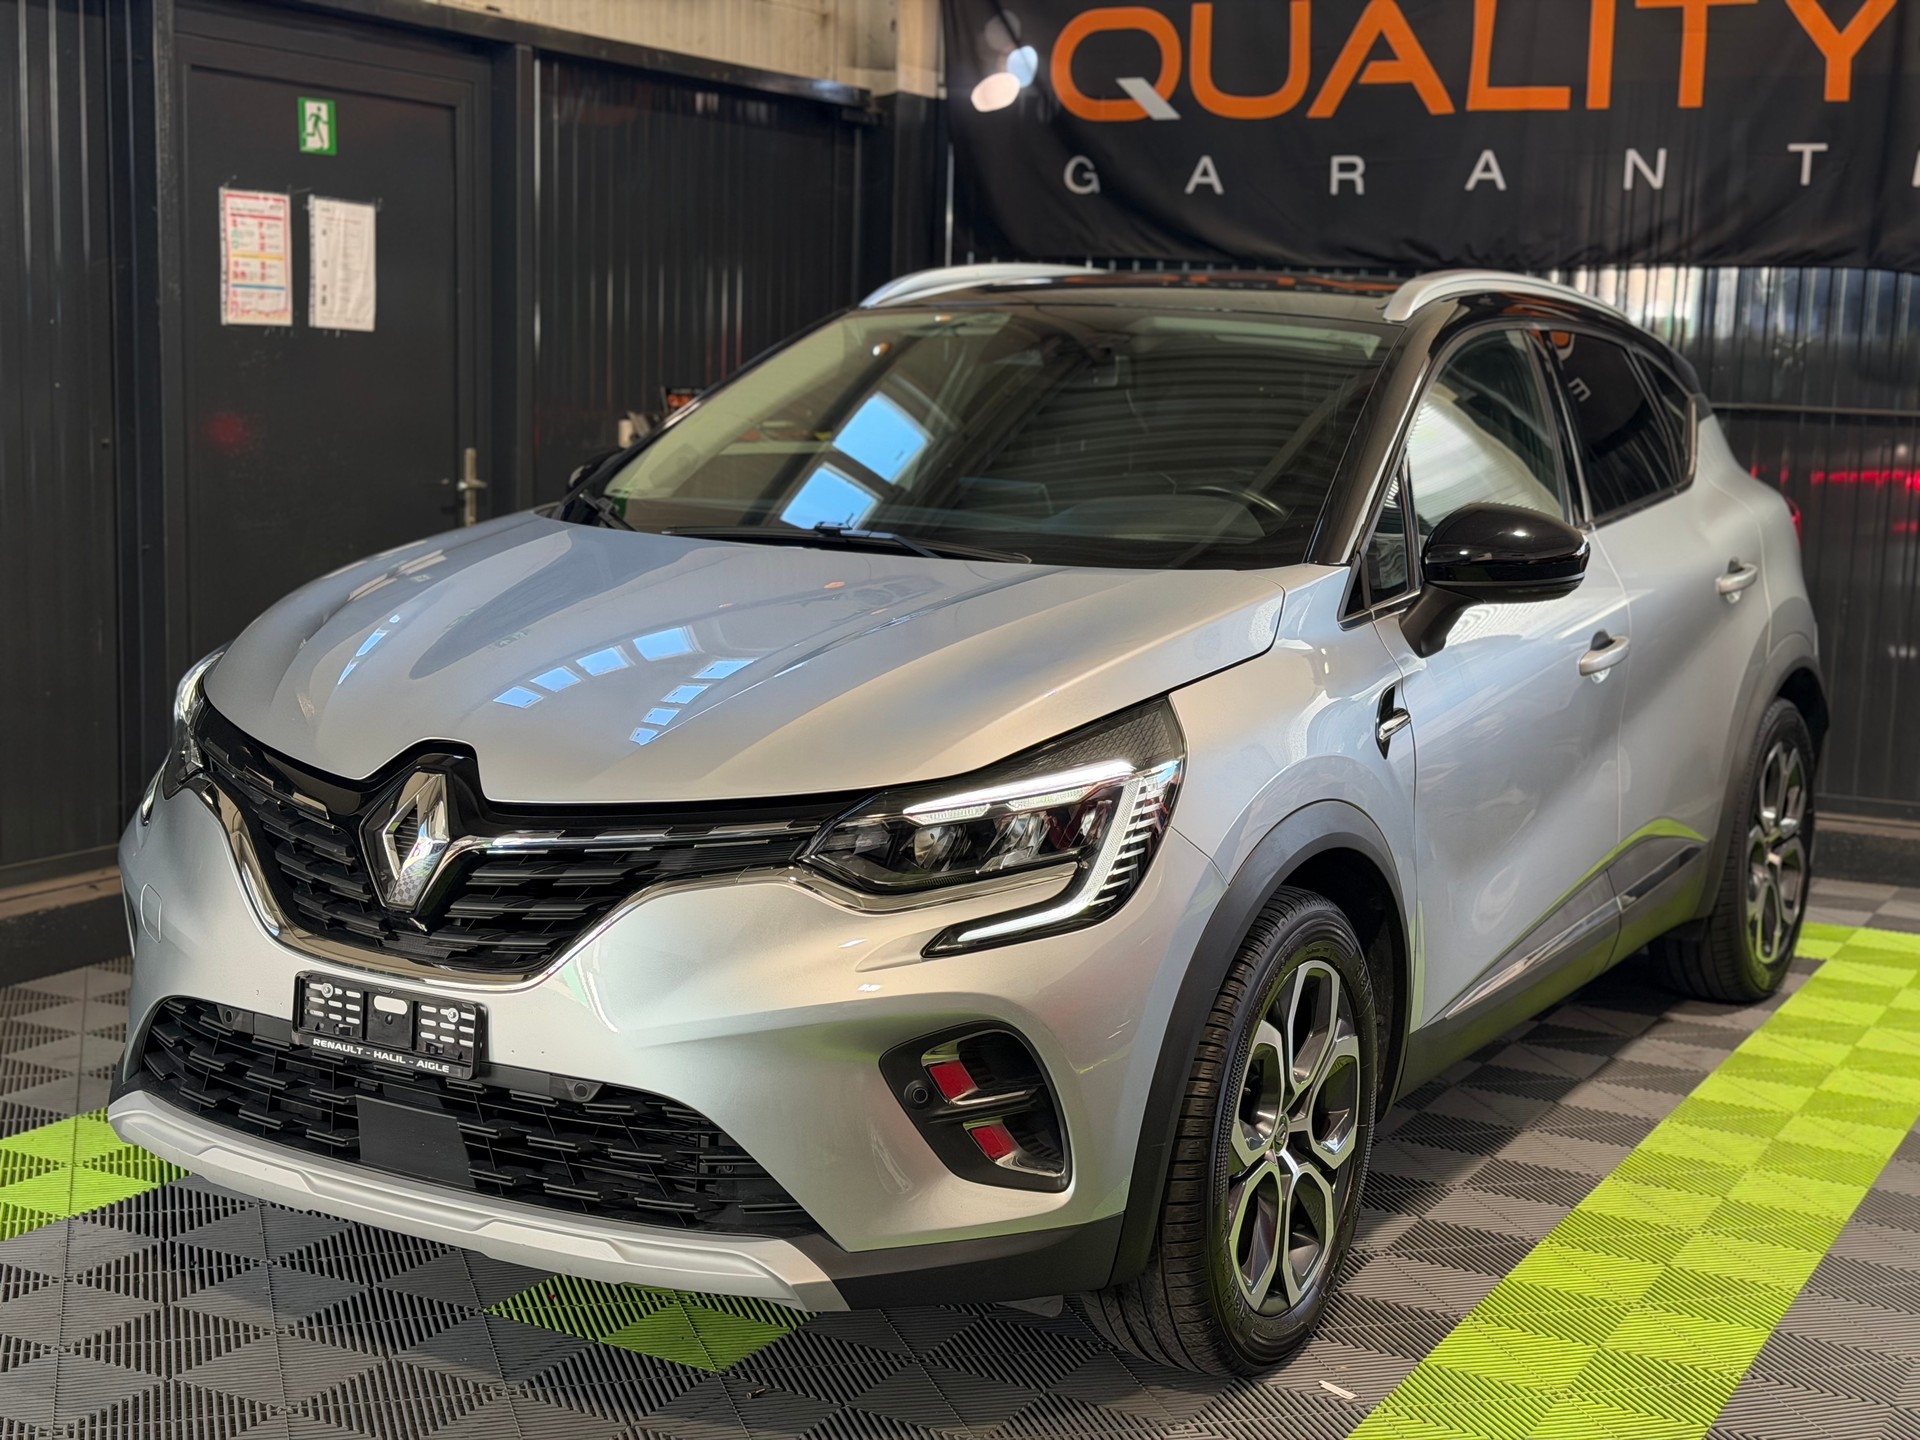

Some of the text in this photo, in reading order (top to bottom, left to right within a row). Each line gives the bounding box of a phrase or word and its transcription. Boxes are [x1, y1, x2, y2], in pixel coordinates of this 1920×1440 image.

[1050, 0, 1897, 122] QUALITY
[1063, 142, 1920, 195] GARANT
[312, 1038, 363, 1056] RENAULT
[373, 1051, 406, 1064] HALIL
[416, 1060, 450, 1073] AIGLE
